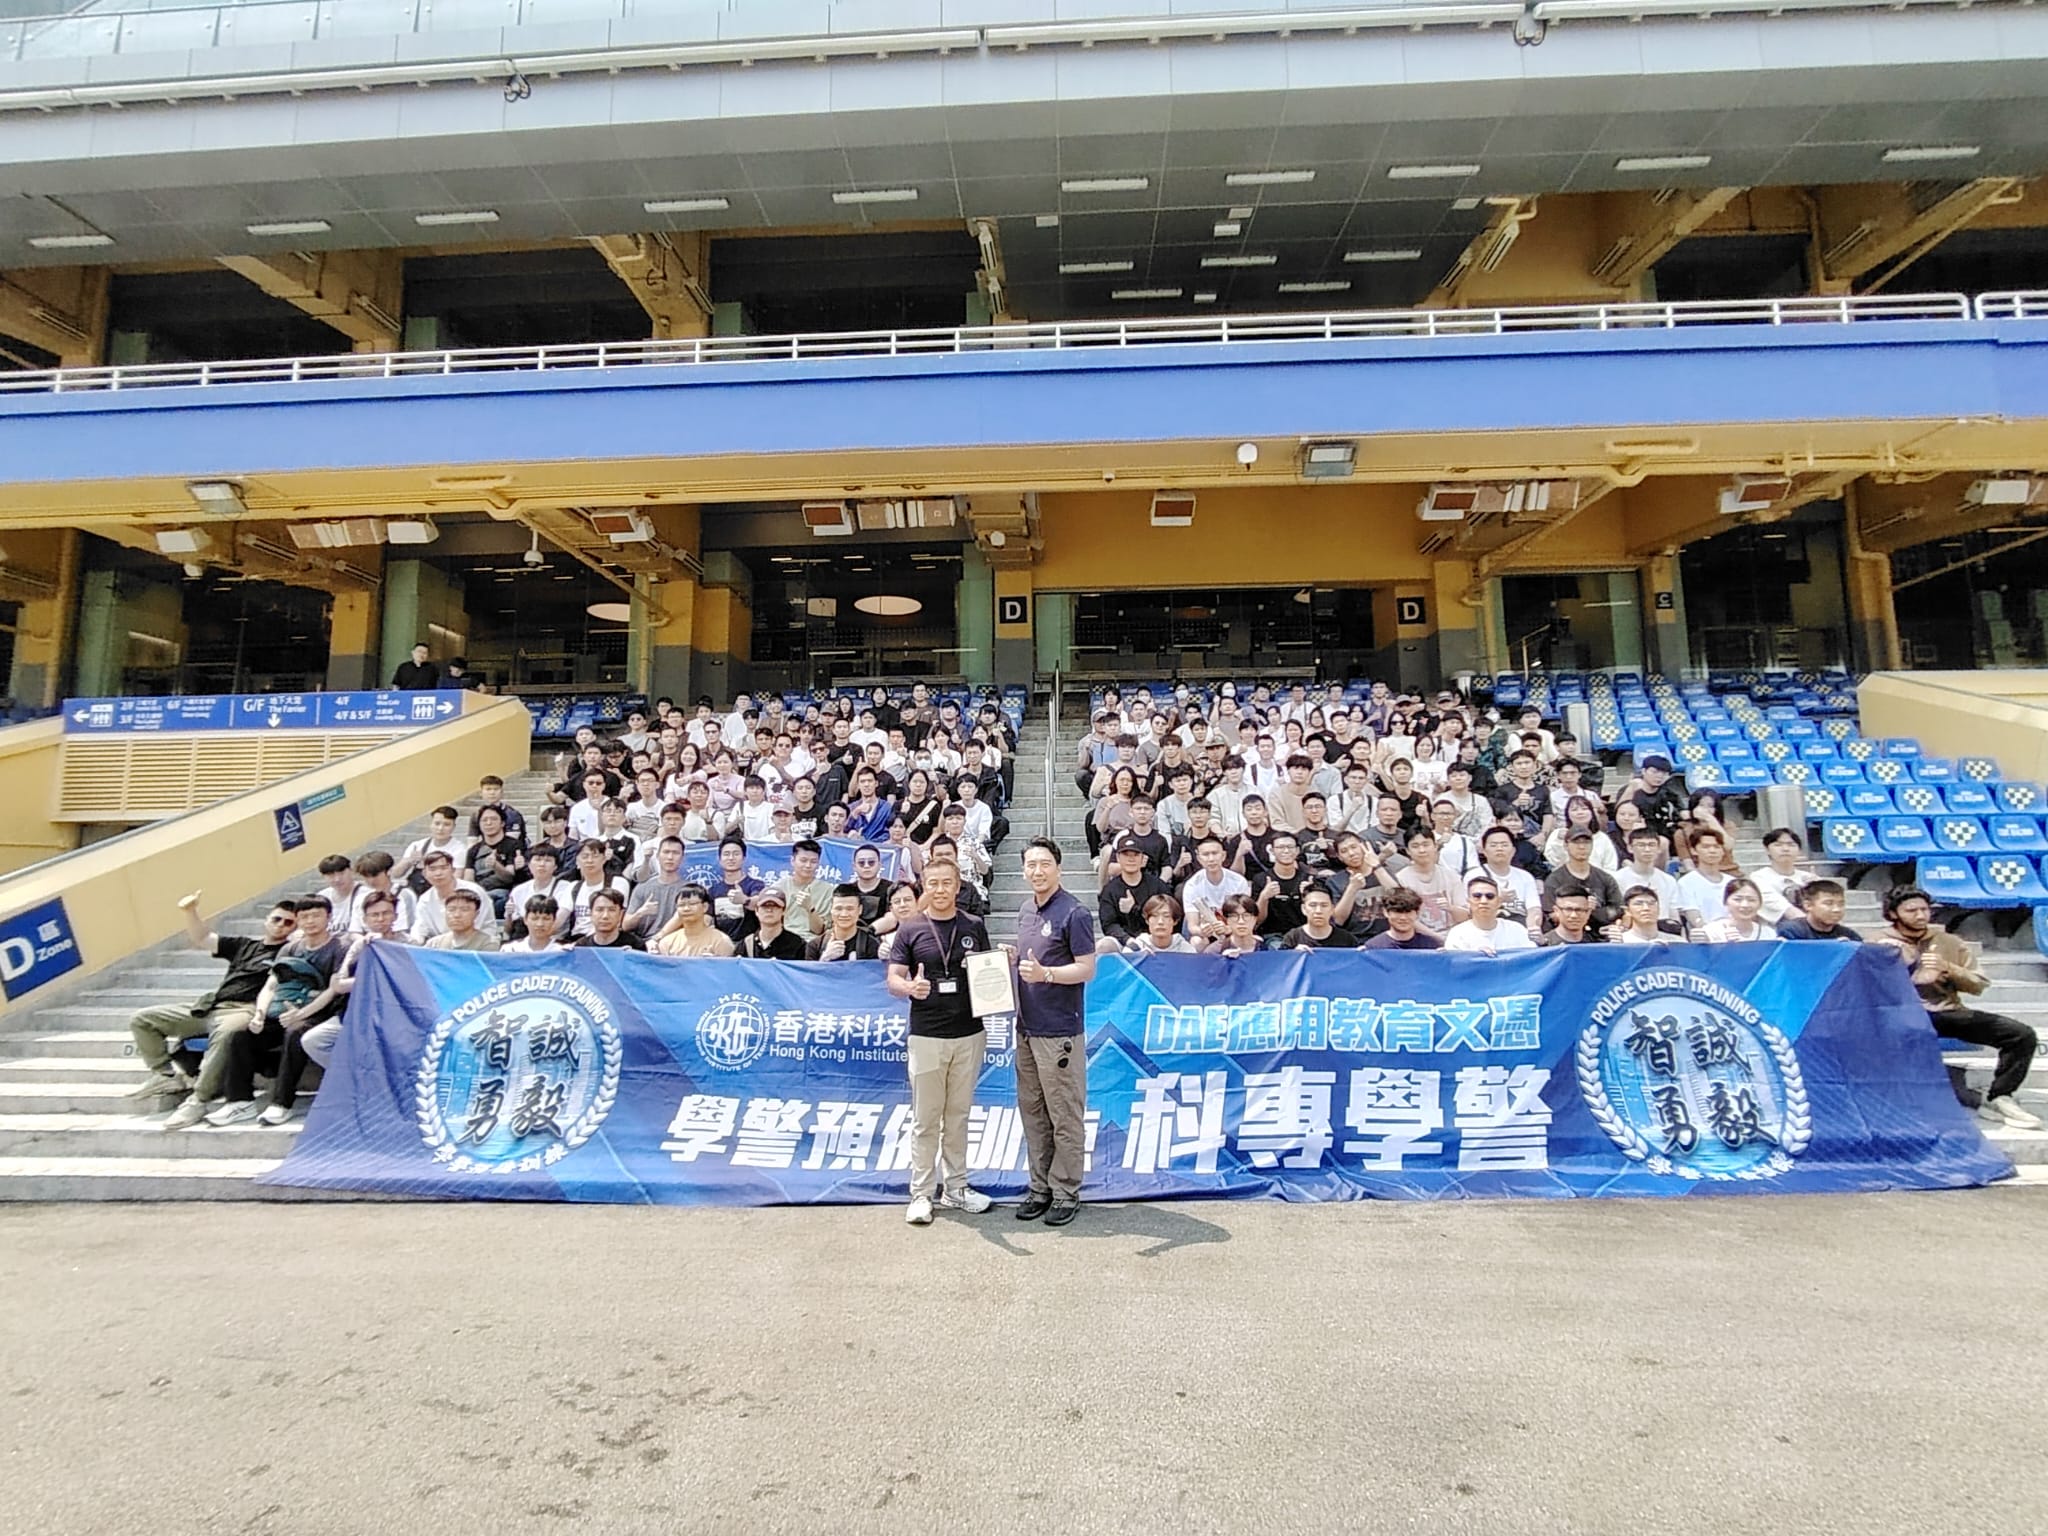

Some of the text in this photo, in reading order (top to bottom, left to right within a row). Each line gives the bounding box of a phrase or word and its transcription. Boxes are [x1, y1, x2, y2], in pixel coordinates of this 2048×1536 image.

[1659, 593, 1670, 603] C
[1005, 601, 1021, 620] D
[1403, 602, 1419, 620] D
[242, 698, 265, 713] G/F
[0, 937, 35, 981] D
[36, 938, 73, 962] Zone
[453, 974, 610, 1025] POLICE CADET TRAINING
[718, 992, 761, 1005] HKIT
[1590, 972, 1761, 1027] POLICE CADET TRAINING
[769, 1044, 908, 1063] Hong Kong Institute
[1121, 1064, 1553, 1174] 科專學警
